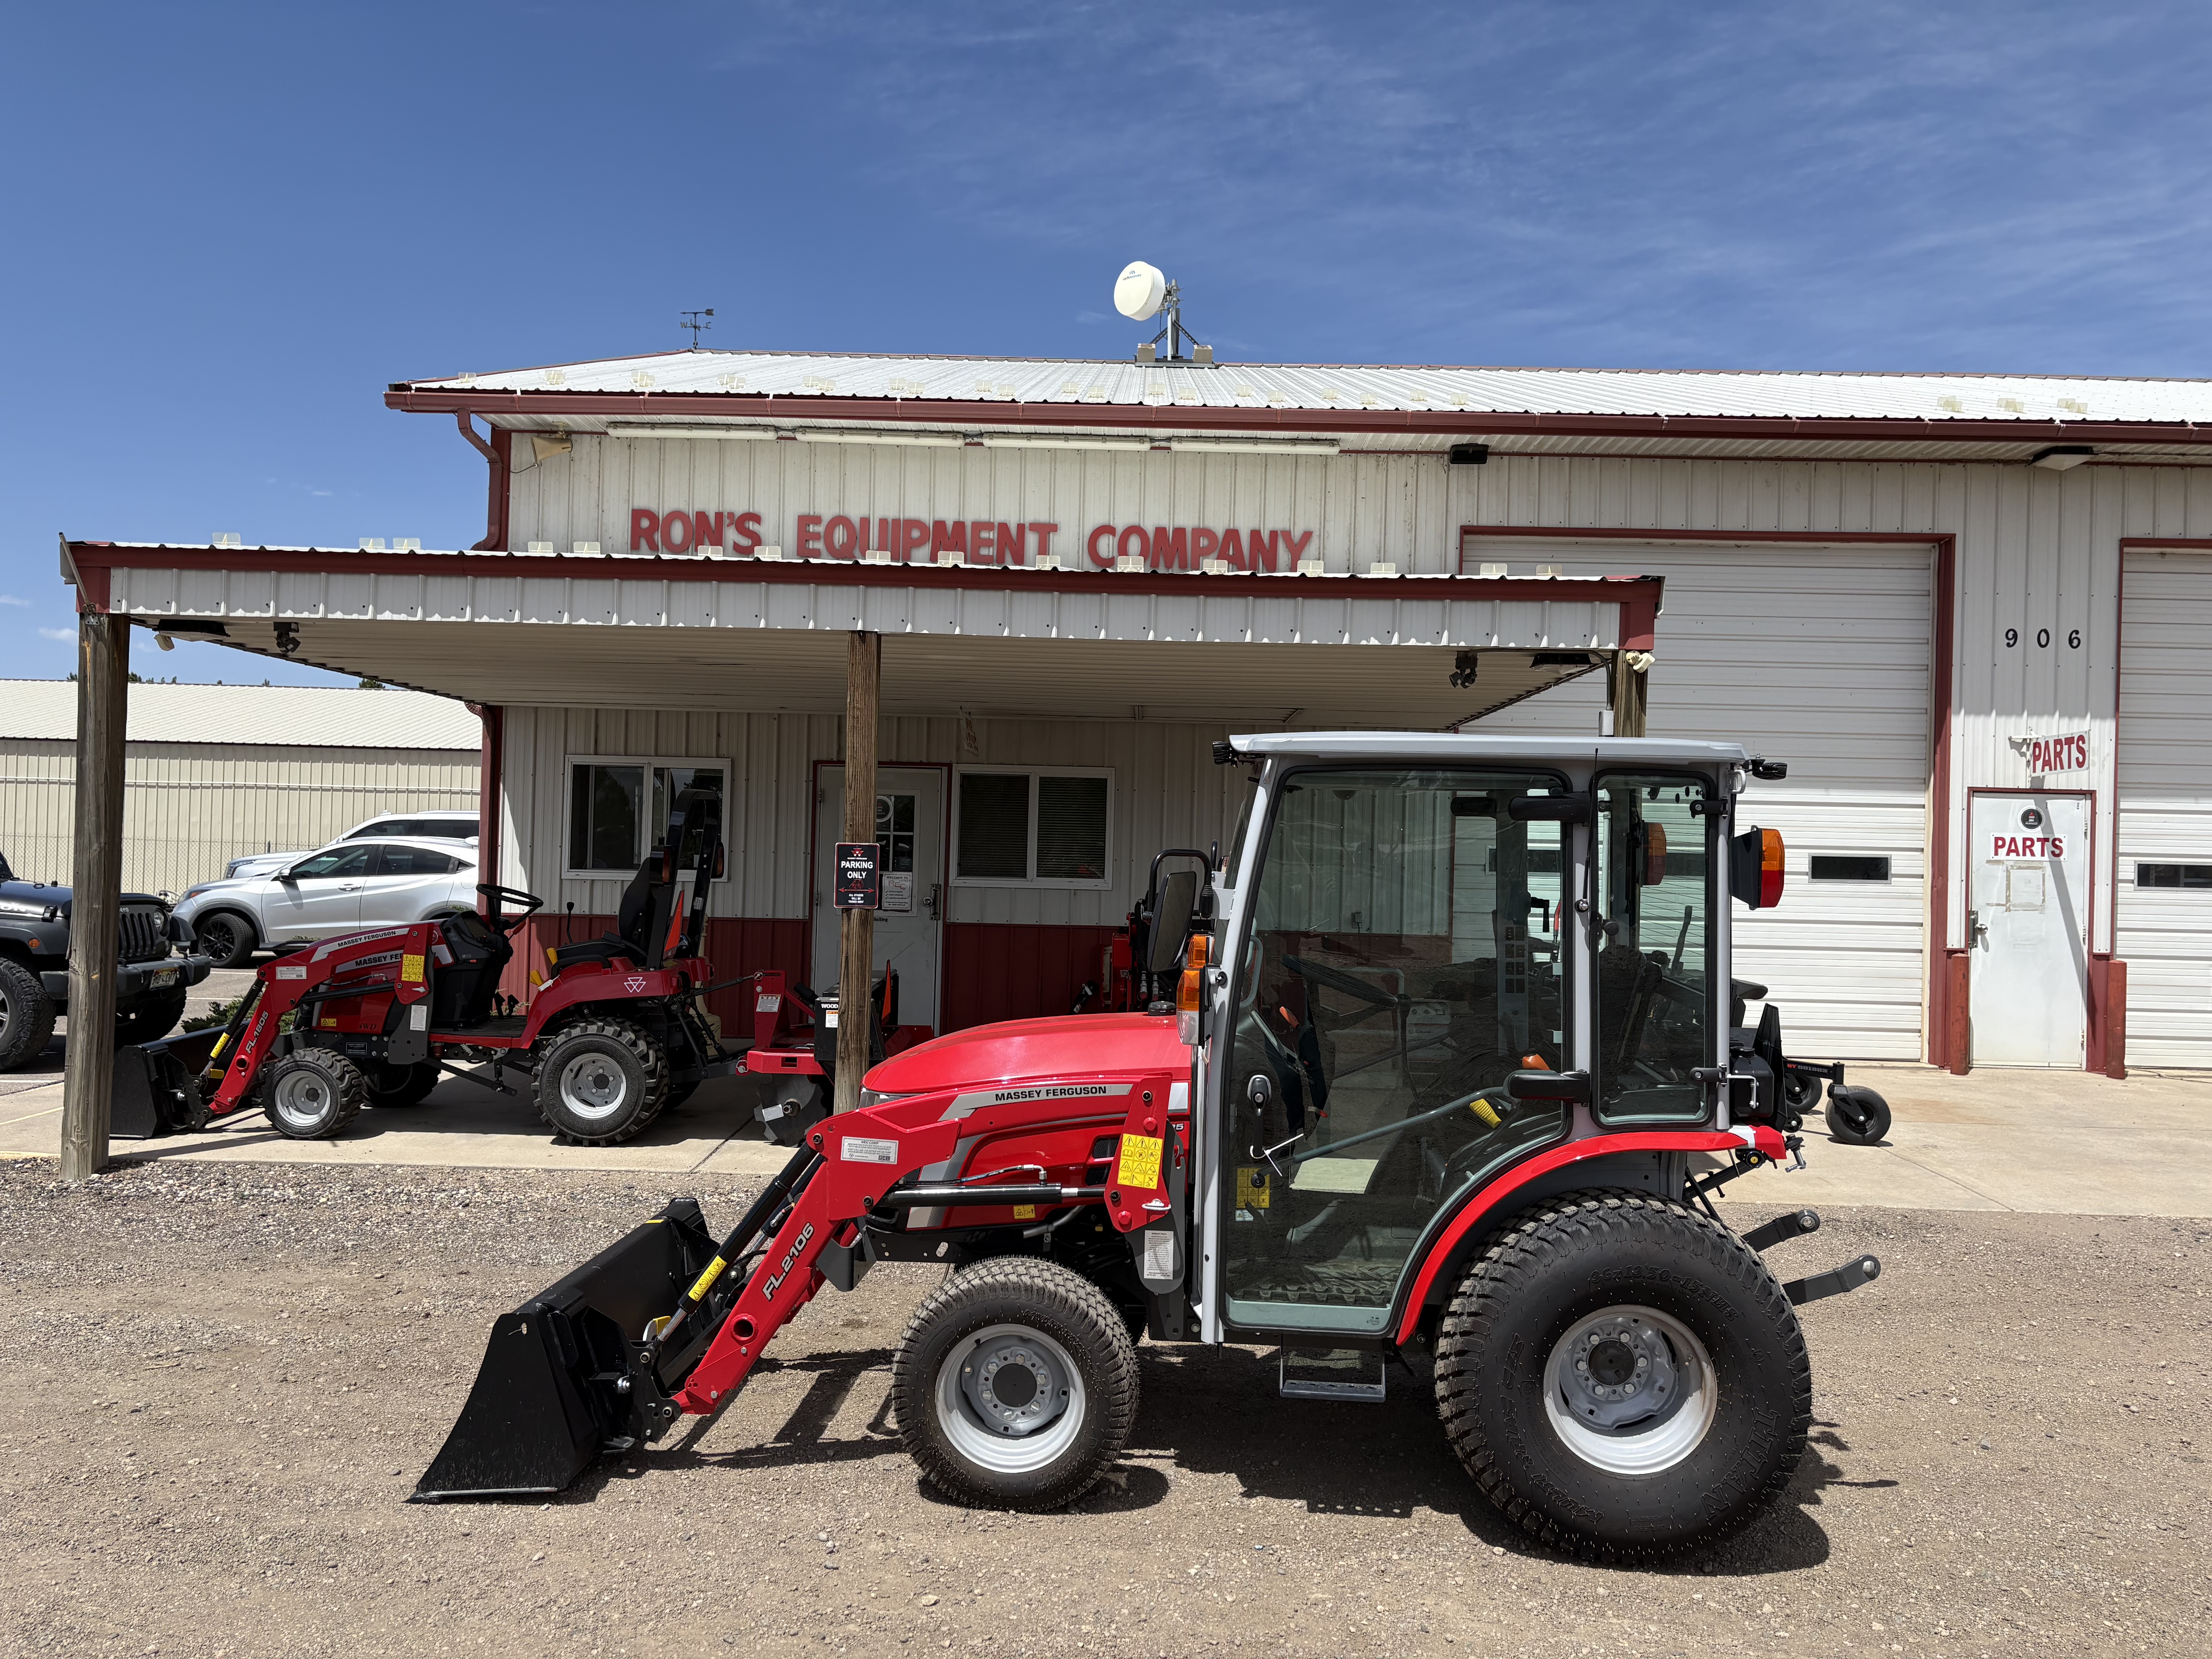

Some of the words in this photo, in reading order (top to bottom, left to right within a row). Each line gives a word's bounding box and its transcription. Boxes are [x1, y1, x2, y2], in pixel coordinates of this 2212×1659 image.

[630, 508, 762, 555] RON'S
[797, 514, 1058, 565] EQUIPMENT
[1088, 524, 1313, 572] COMPANY
[2032, 734, 2087, 773] PARTS
[1994, 837, 2064, 857] PARTS
[338, 937, 362, 947] MASSEY
[364, 931, 396, 941] FERGUSON
[355, 955, 387, 967] MASSEY
[995, 1089, 1042, 1101] MASSEY
[1046, 1086, 1106, 1097] FERGUSON
[762, 1222, 814, 1300] FL.2106
[1700, 1407, 1781, 1521] TITAN
